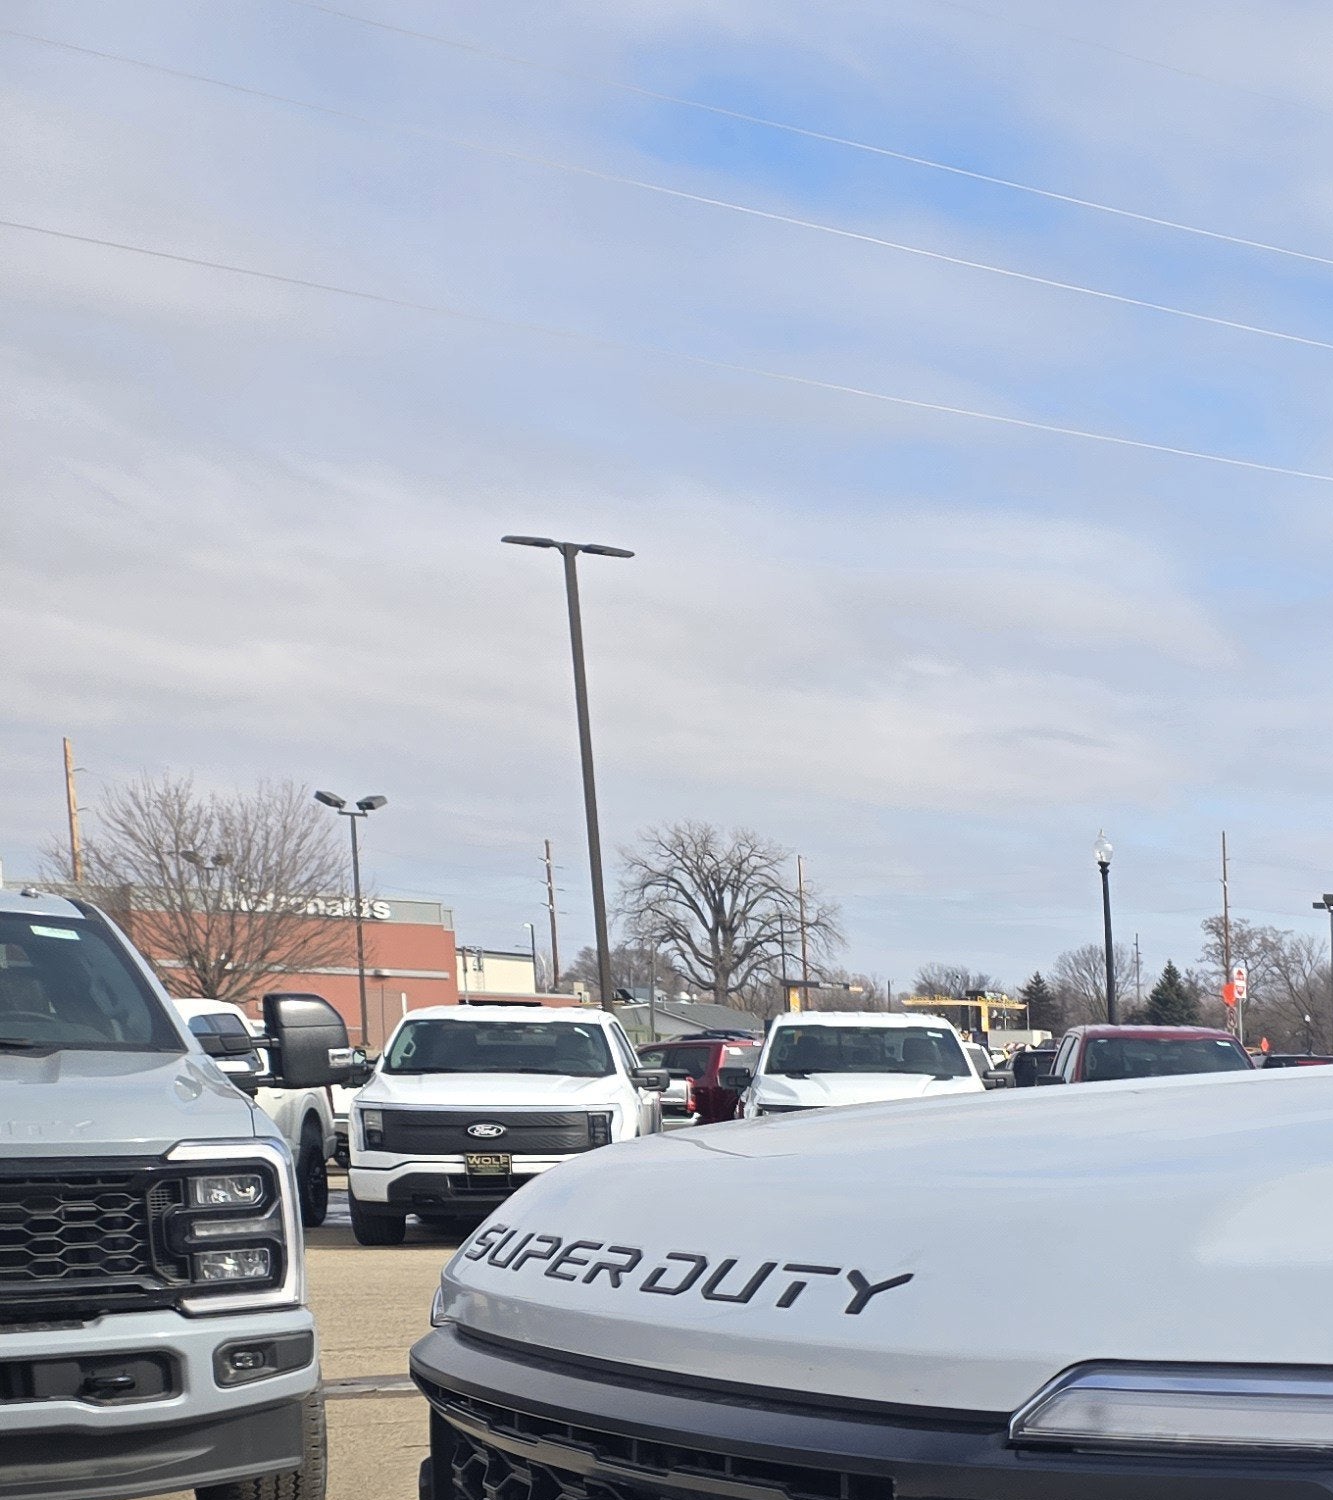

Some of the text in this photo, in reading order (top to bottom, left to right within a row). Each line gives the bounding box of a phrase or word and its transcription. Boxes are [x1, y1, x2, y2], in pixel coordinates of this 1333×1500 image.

[467, 1155, 508, 1165] WOLF
[466, 1225, 914, 1315] SUPER DUTY
